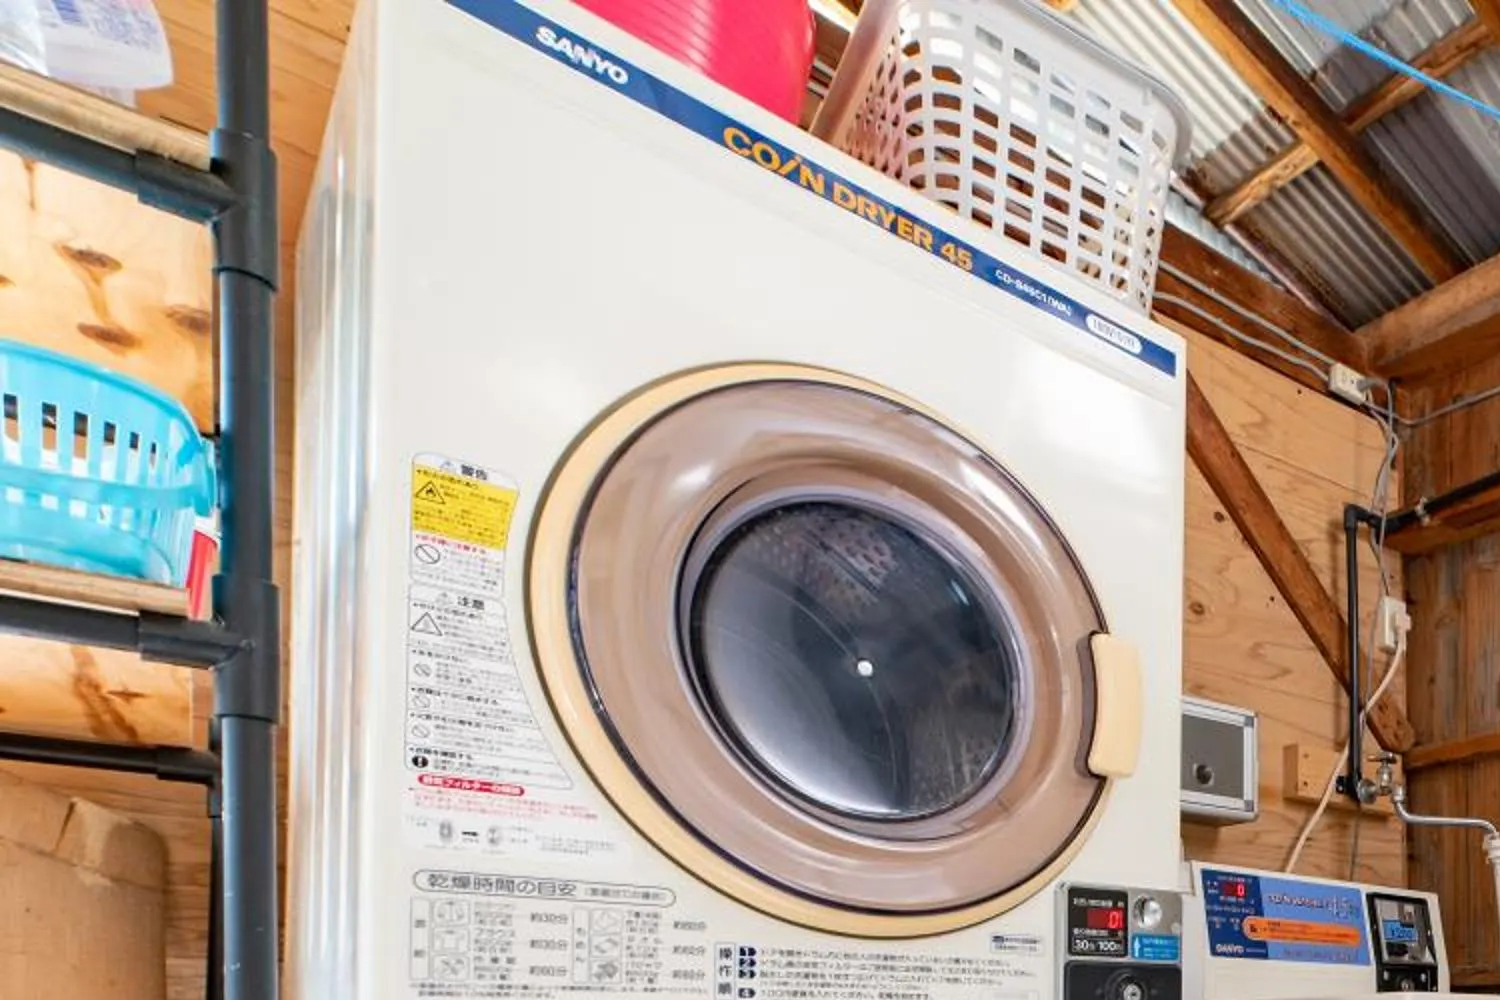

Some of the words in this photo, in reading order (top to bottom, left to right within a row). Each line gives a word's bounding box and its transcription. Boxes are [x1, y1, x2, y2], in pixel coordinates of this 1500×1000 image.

[535, 25, 629, 85] SANYO
[832, 181, 933, 252] DRYER
[939, 242, 973, 272] 45
[427, 873, 577, 897] 乾燥時間の目安
